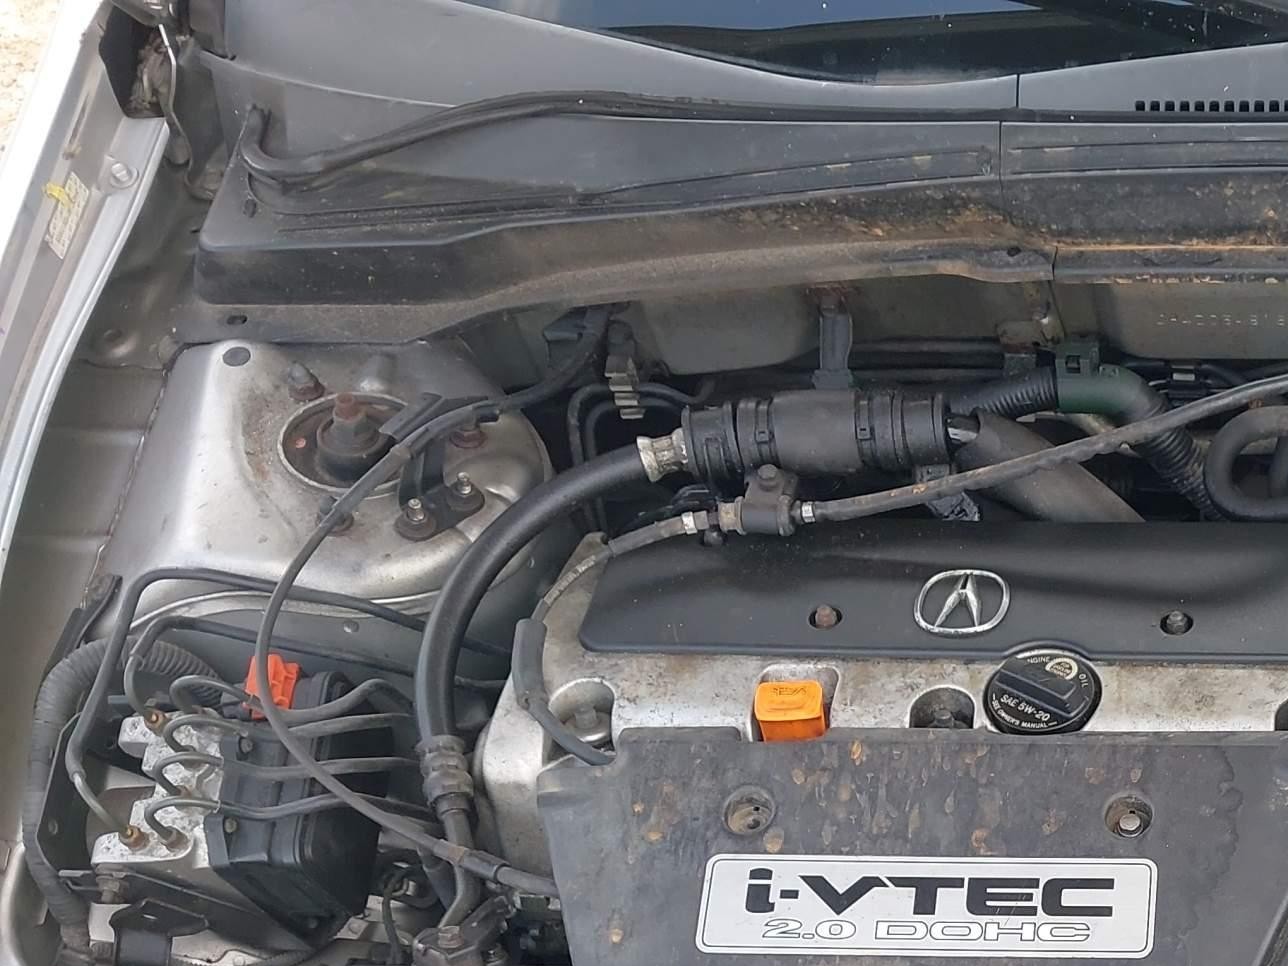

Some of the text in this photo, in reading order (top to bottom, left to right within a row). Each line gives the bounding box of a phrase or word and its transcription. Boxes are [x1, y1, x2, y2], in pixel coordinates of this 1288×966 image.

[1078, 673, 1089, 688] OIL
[1001, 694, 1051, 721] SAE 5W-20
[745, 868, 1115, 917] i-VTEC
[762, 919, 1091, 942] 2.0 DOHC
